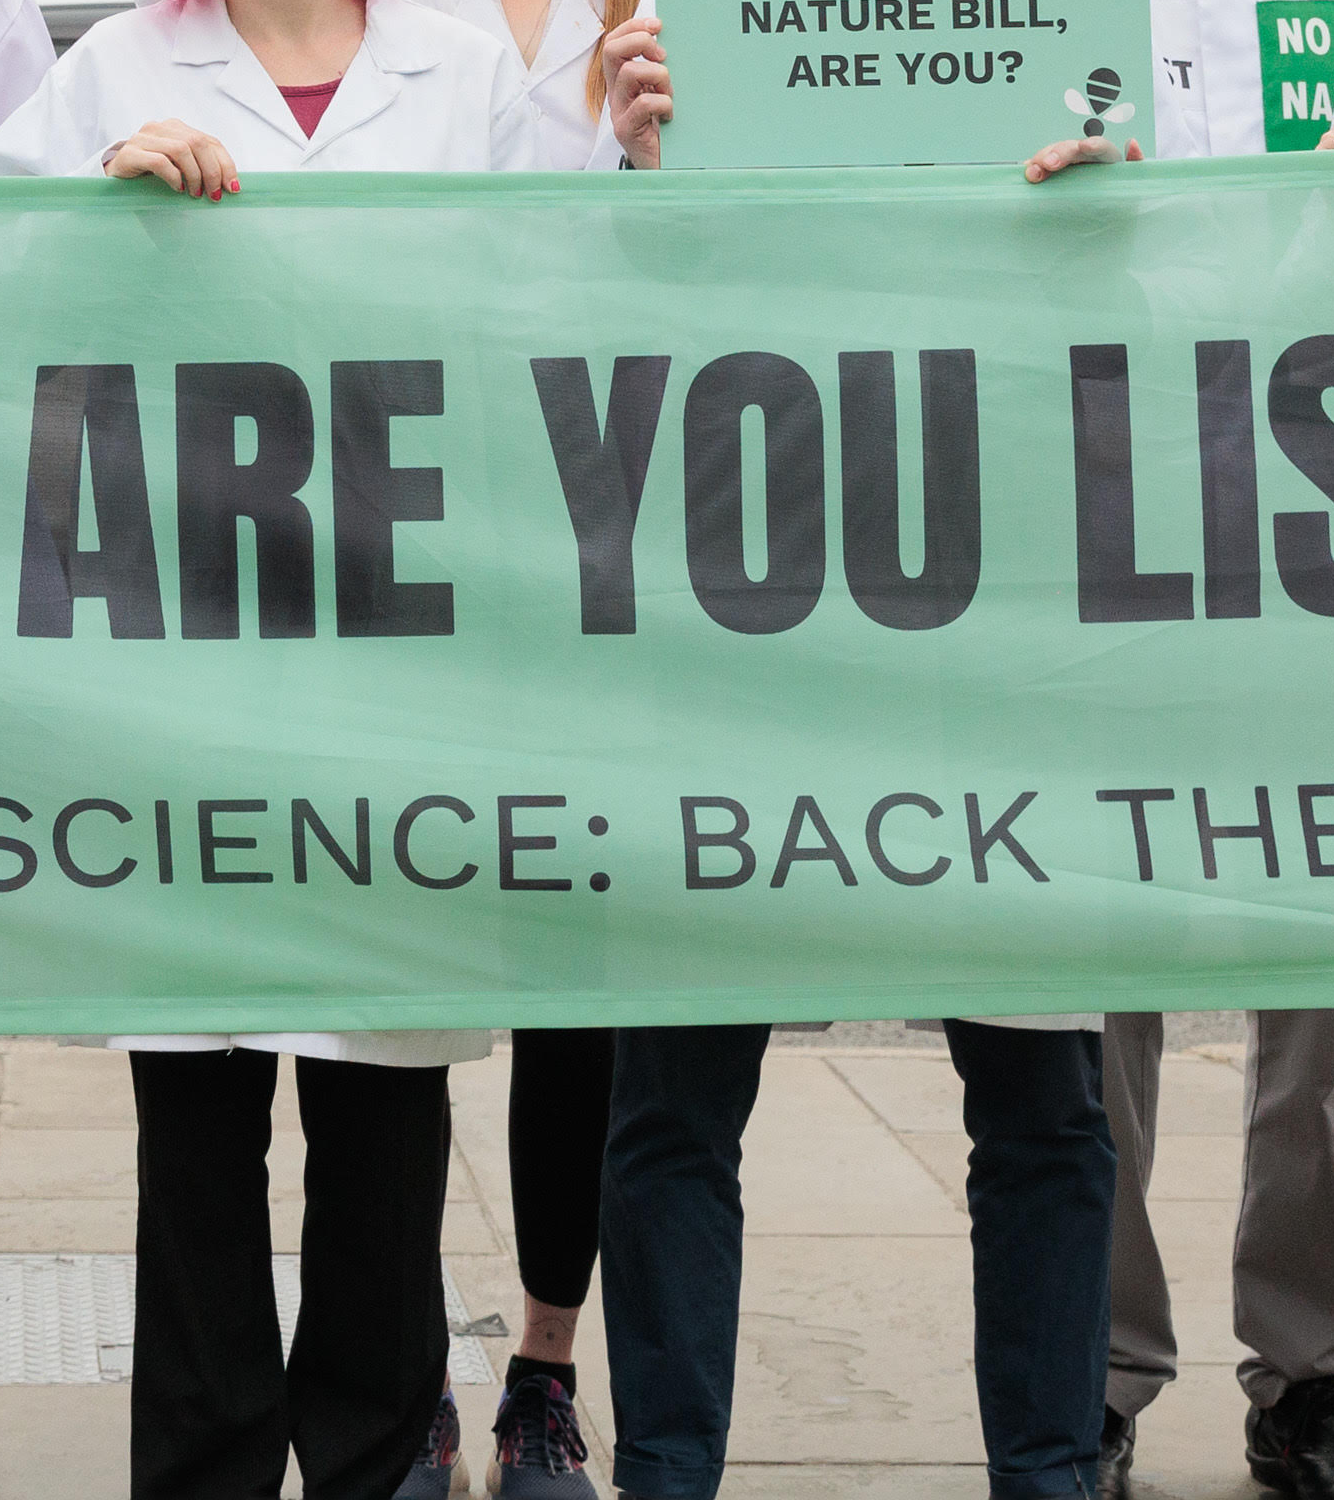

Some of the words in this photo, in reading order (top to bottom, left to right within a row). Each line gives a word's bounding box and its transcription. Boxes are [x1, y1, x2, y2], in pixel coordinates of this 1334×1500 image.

[787, 54, 881, 88] ARE
[896, 50, 1023, 85] YOU?
[1276, 16, 1331, 56] NO
[17, 360, 456, 640] ARE
[530, 348, 983, 636] YOU
[681, 787, 1049, 891] BACK
